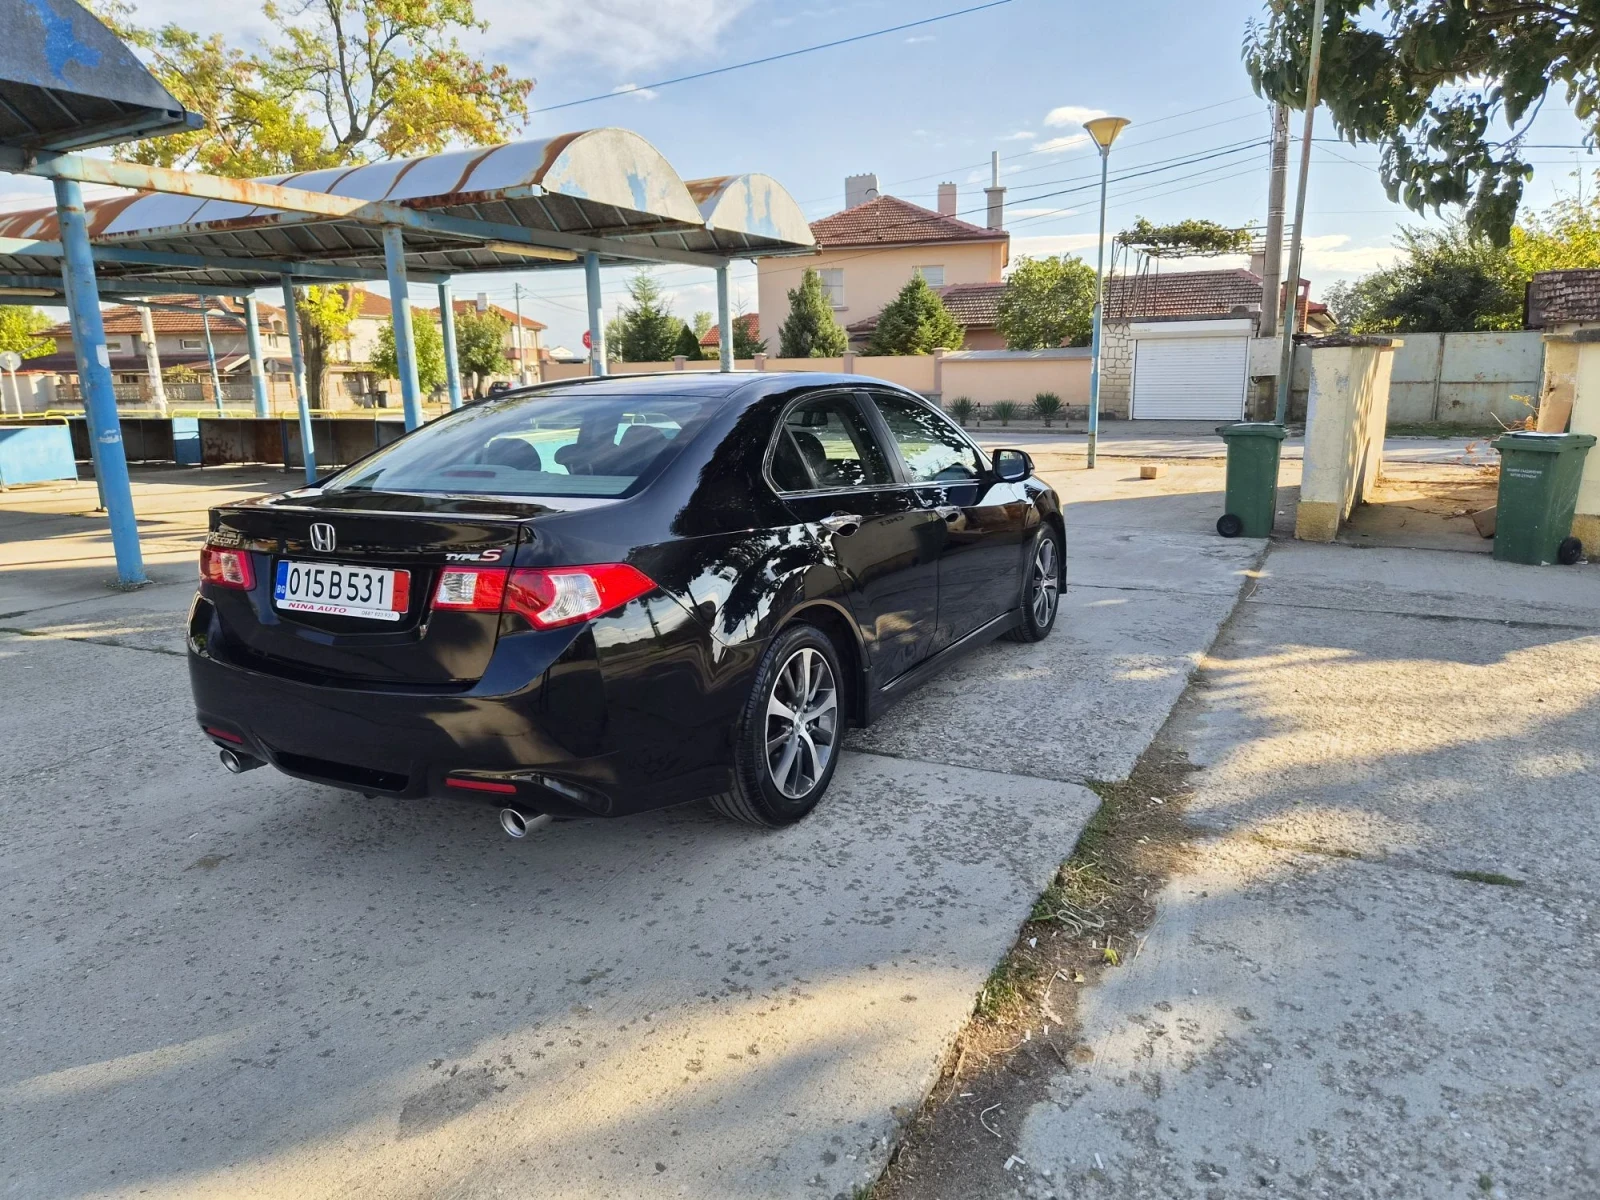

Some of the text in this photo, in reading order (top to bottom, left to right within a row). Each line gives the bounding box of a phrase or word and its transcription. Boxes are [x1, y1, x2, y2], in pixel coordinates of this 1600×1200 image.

[276, 585, 286, 594] BG
[288, 602, 347, 614] NINA AUTO
